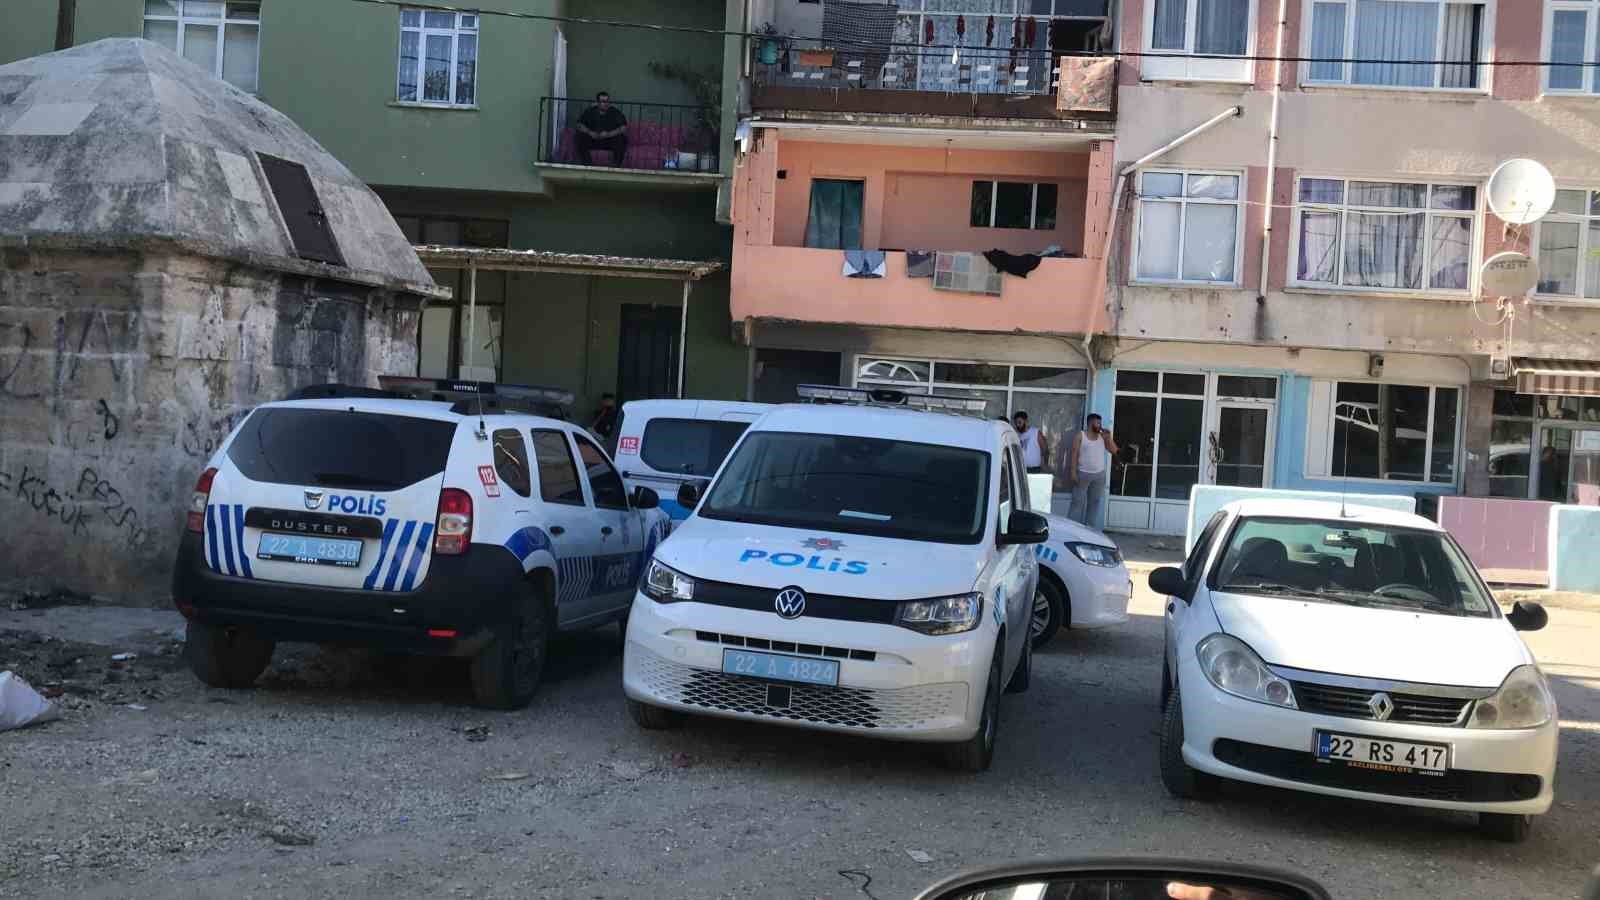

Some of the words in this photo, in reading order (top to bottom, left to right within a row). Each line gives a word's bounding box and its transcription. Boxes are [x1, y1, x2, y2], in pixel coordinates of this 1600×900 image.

[623, 438, 637, 449] 112
[480, 468, 496, 483] 112
[328, 495, 386, 516] POLİS
[272, 520, 348, 534] DUSTER
[271, 539, 289, 553] 22
[738, 549, 869, 575] POLİS
[735, 655, 757, 673] 22
[767, 656, 777, 676] A
[787, 660, 834, 681] 4824
[1330, 738, 1354, 757] 22
[1369, 742, 1395, 762] RS
[1405, 746, 1443, 768] 417
